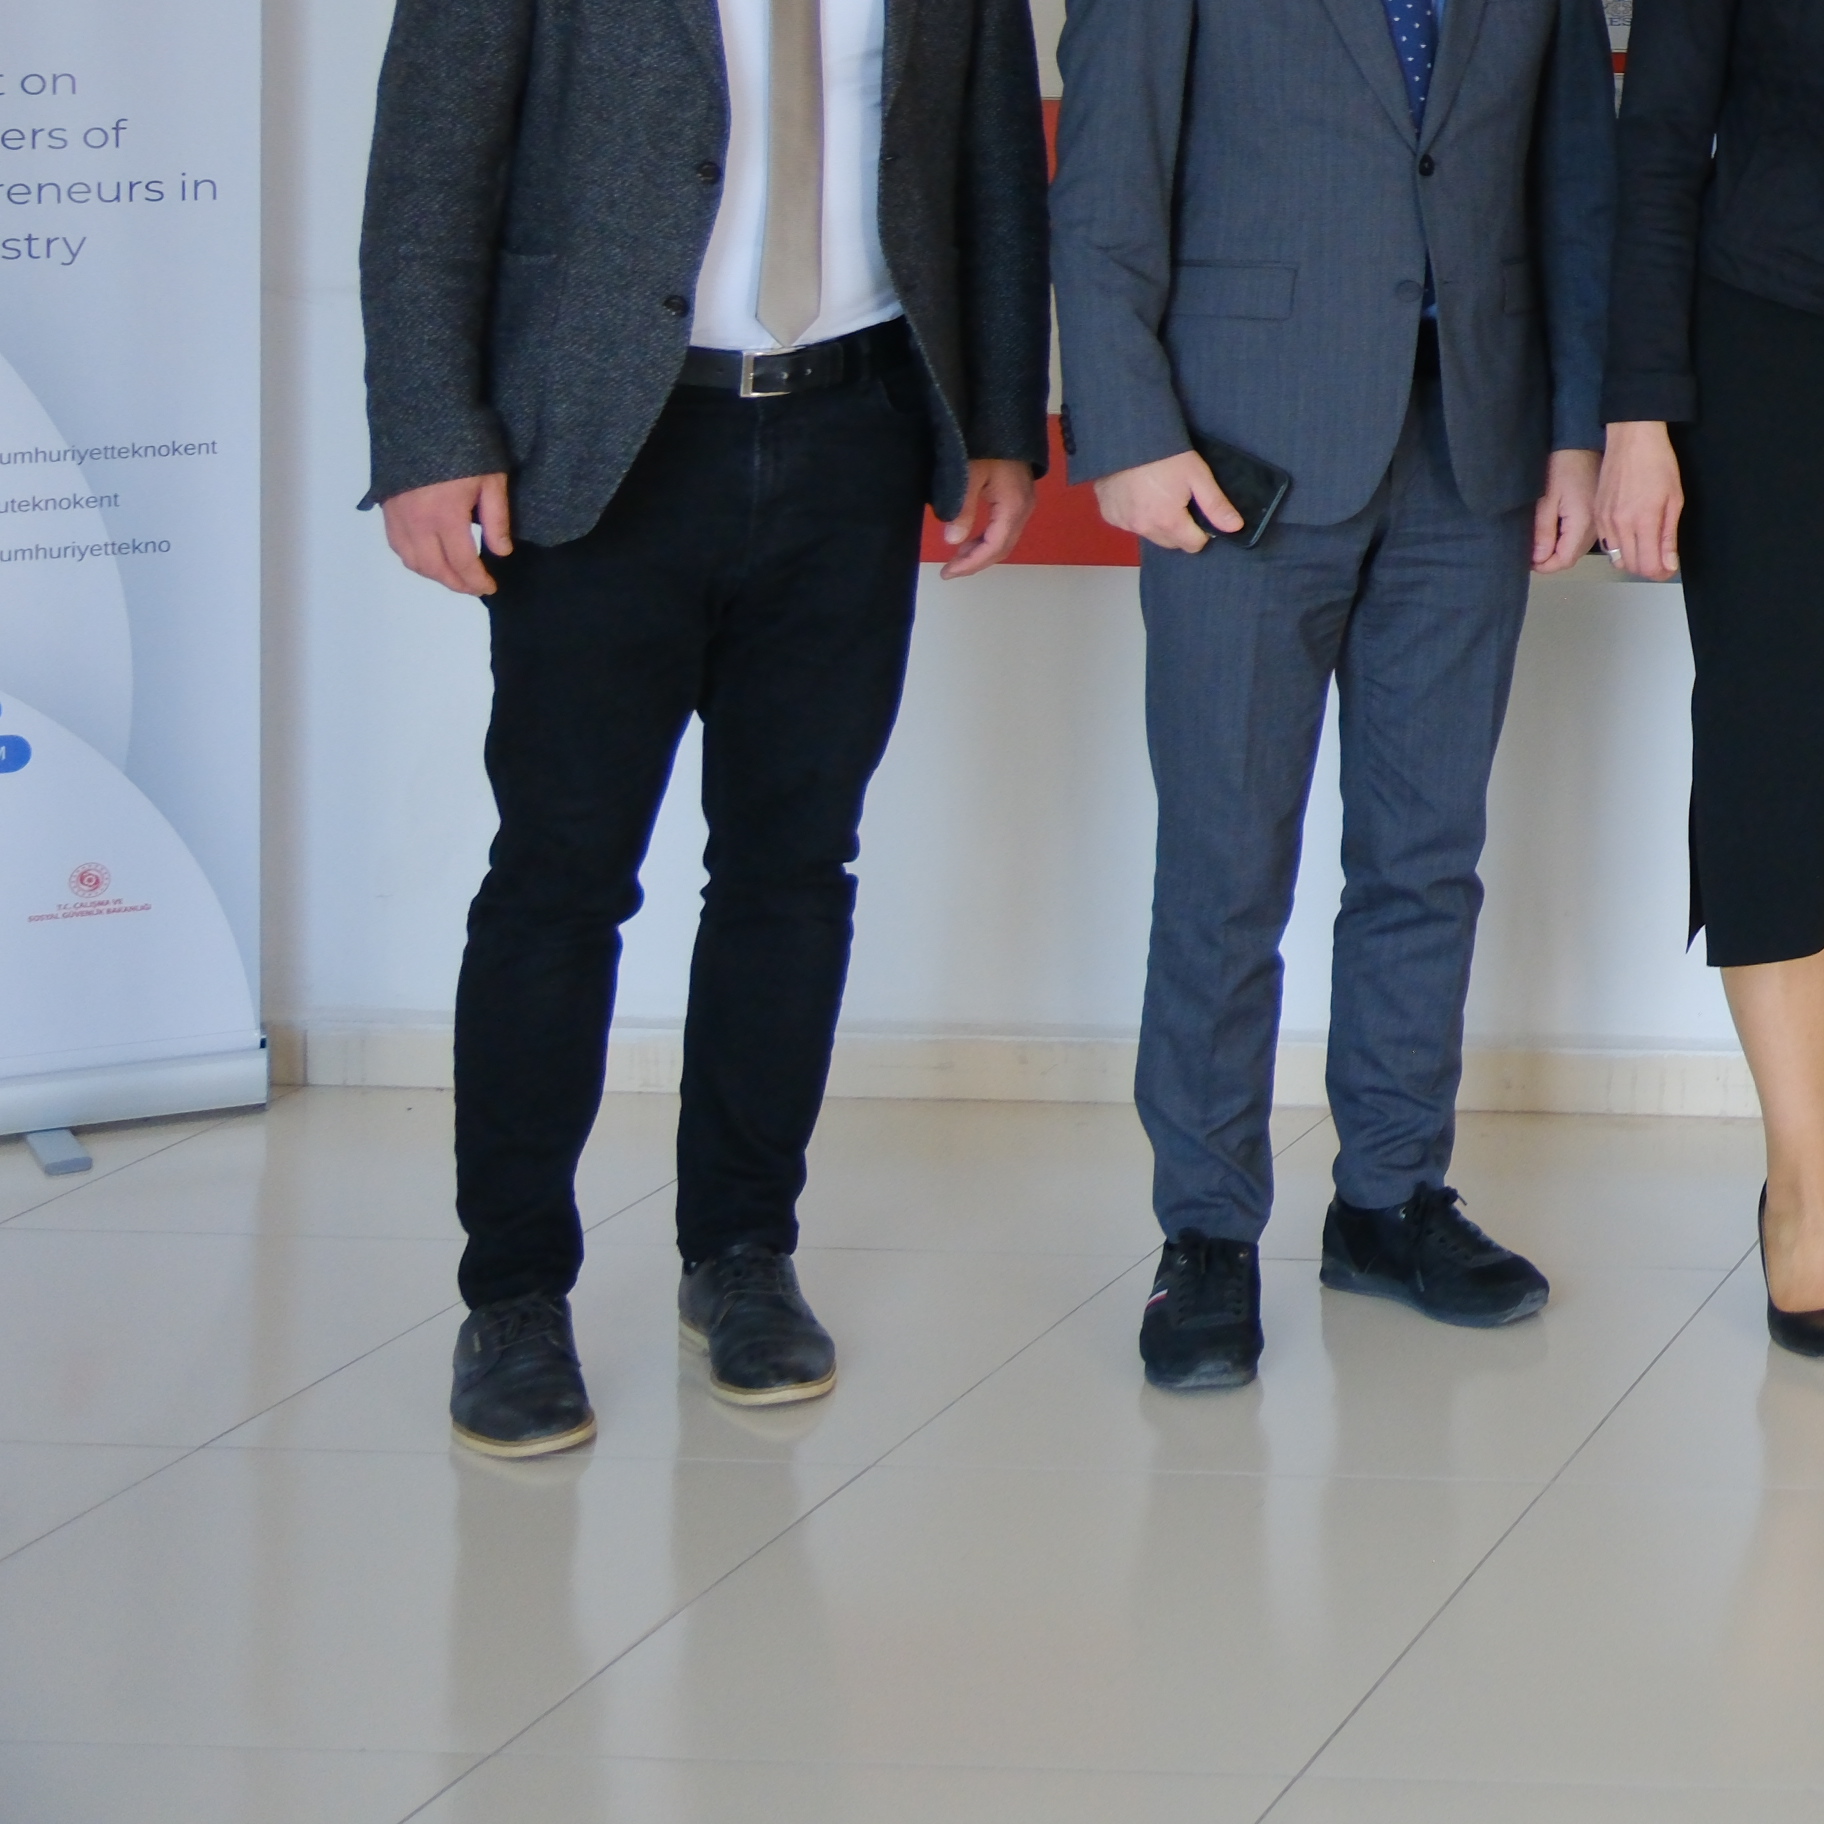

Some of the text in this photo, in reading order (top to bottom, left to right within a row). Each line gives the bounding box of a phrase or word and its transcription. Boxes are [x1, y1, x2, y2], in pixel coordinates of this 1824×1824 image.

[20, 72, 77, 96] on
[83, 119, 128, 149] of
[180, 172, 217, 202] in
[1, 233, 87, 266] stry
